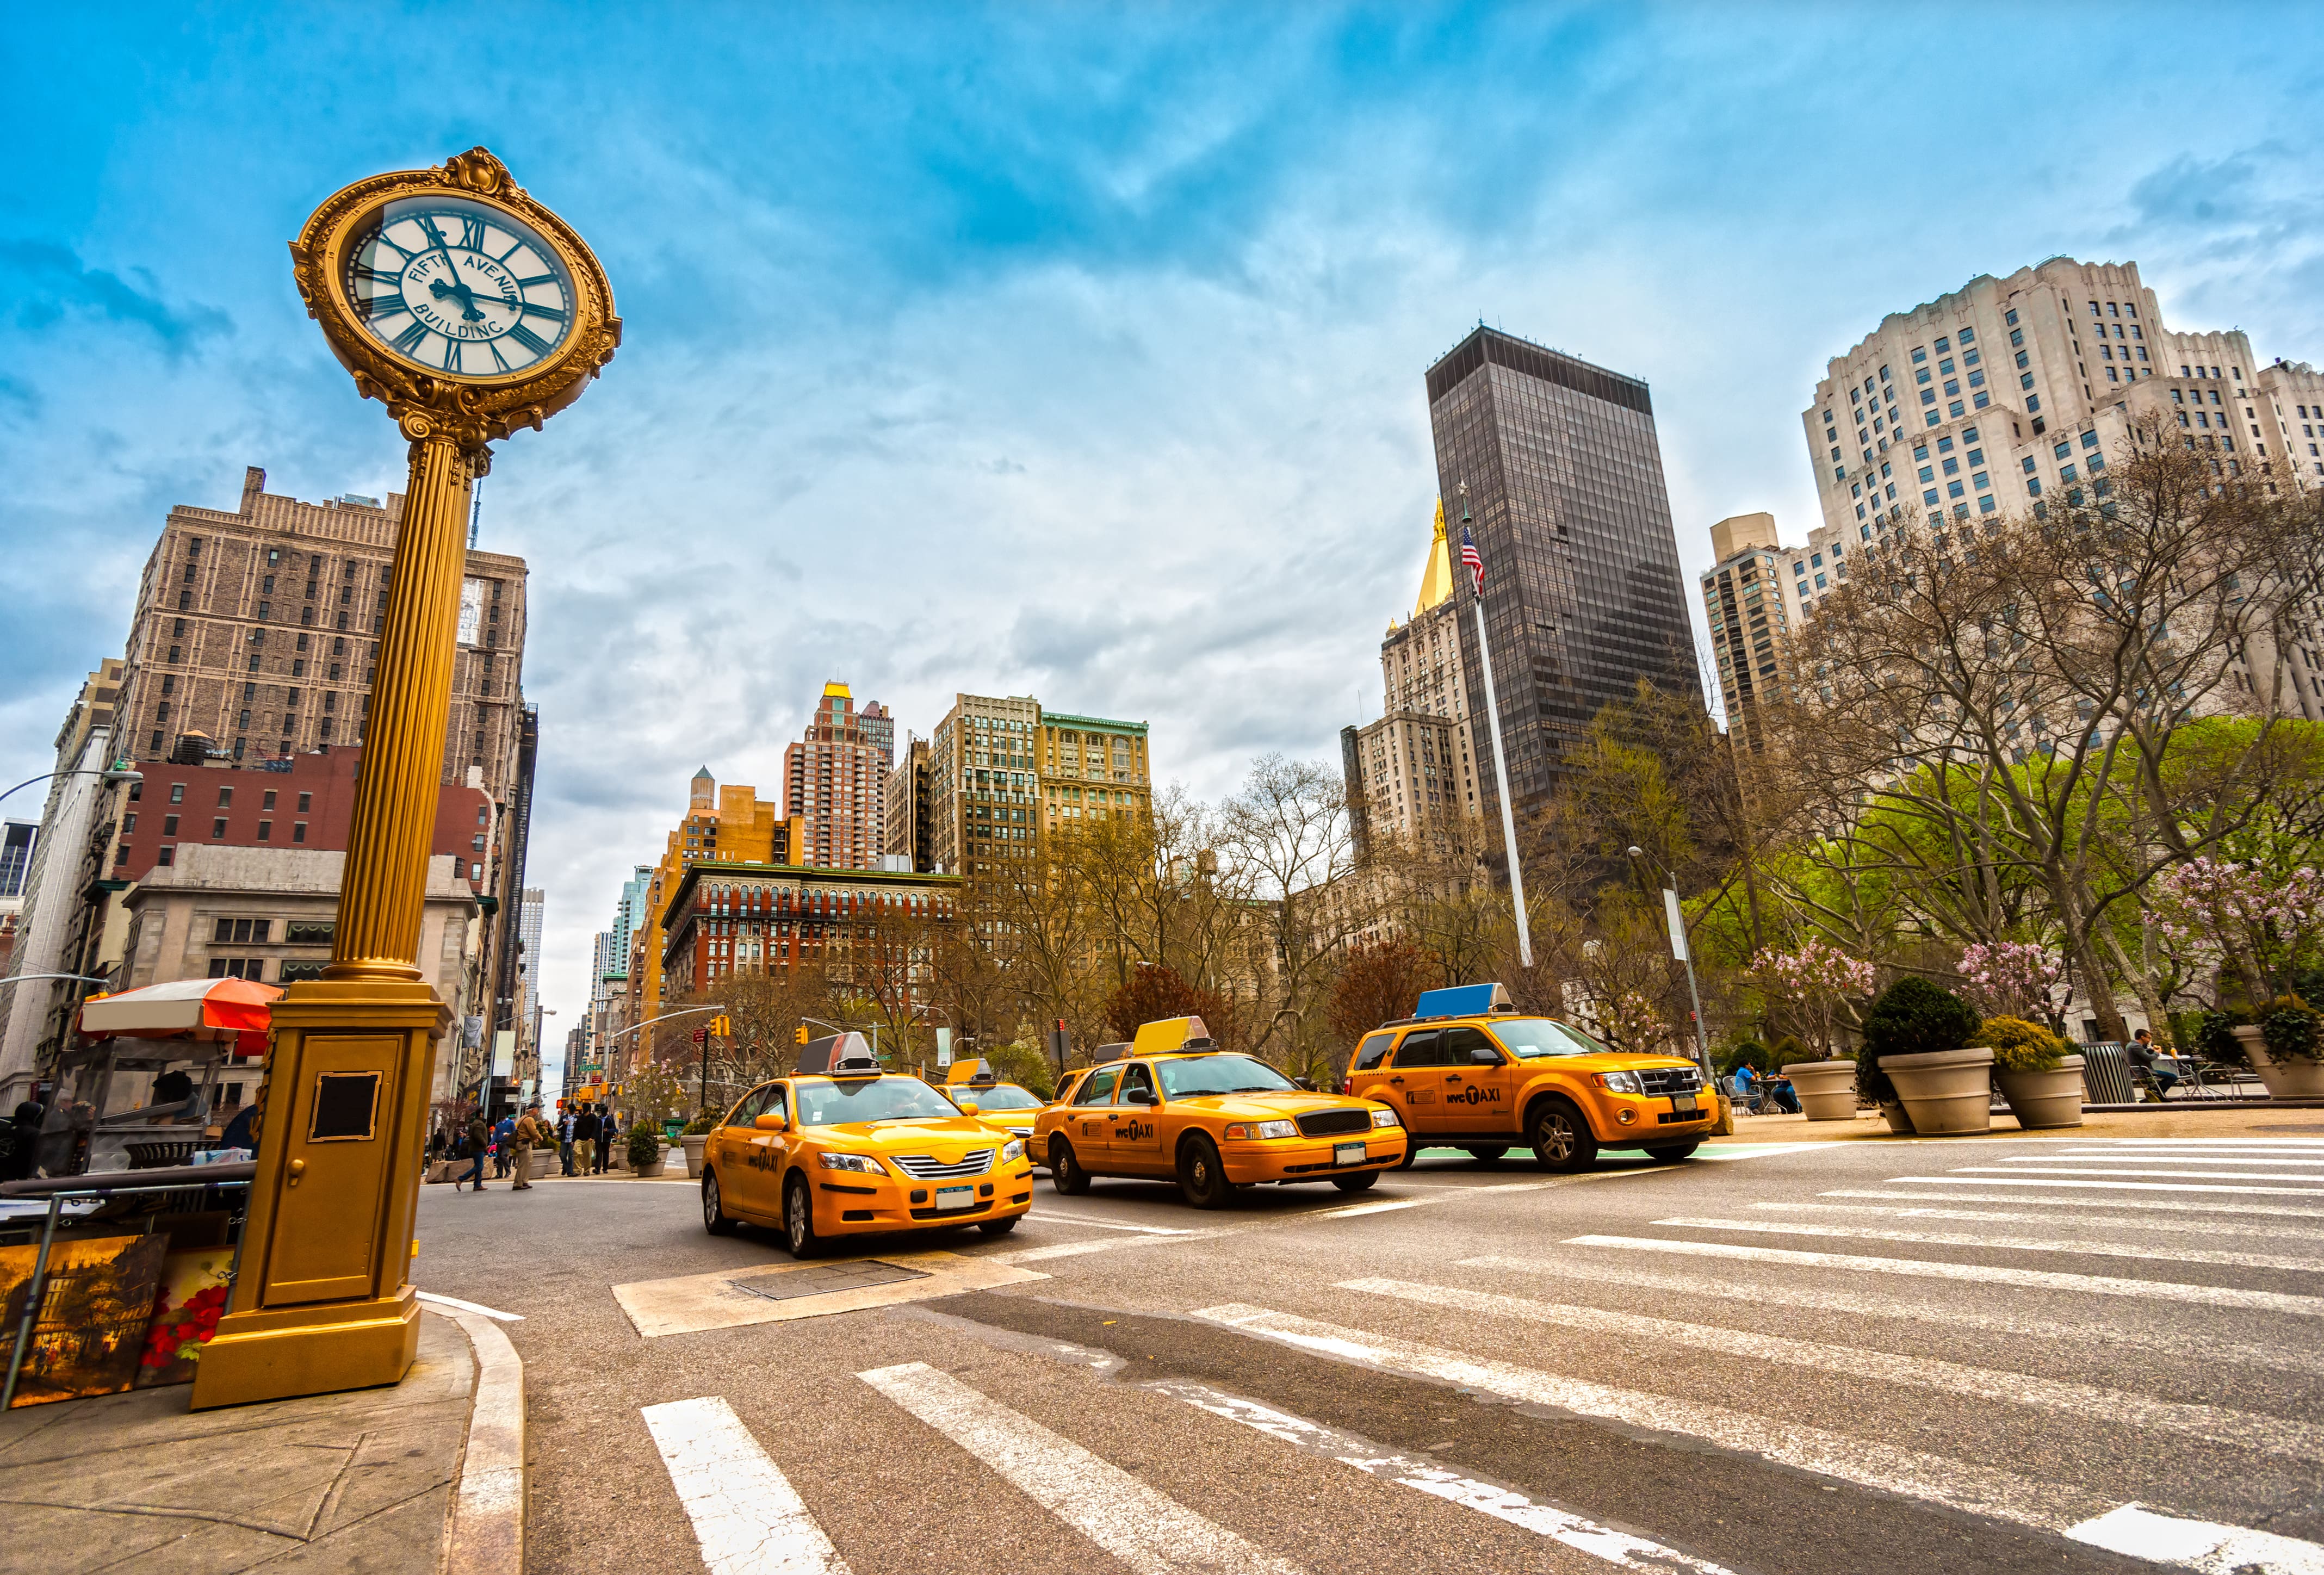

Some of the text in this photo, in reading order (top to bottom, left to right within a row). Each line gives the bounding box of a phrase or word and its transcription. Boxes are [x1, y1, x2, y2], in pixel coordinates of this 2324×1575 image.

[459, 218, 486, 252] XII
[408, 254, 447, 283] FIFTH
[413, 303, 504, 338] BUILDING
[1447, 1094, 1465, 1103] NYC
[1466, 1087, 1500, 1104] TAXI
[1115, 1128, 1128, 1138] NYC
[1129, 1120, 1153, 1140] TAXI
[759, 1148, 778, 1173] TAXI
